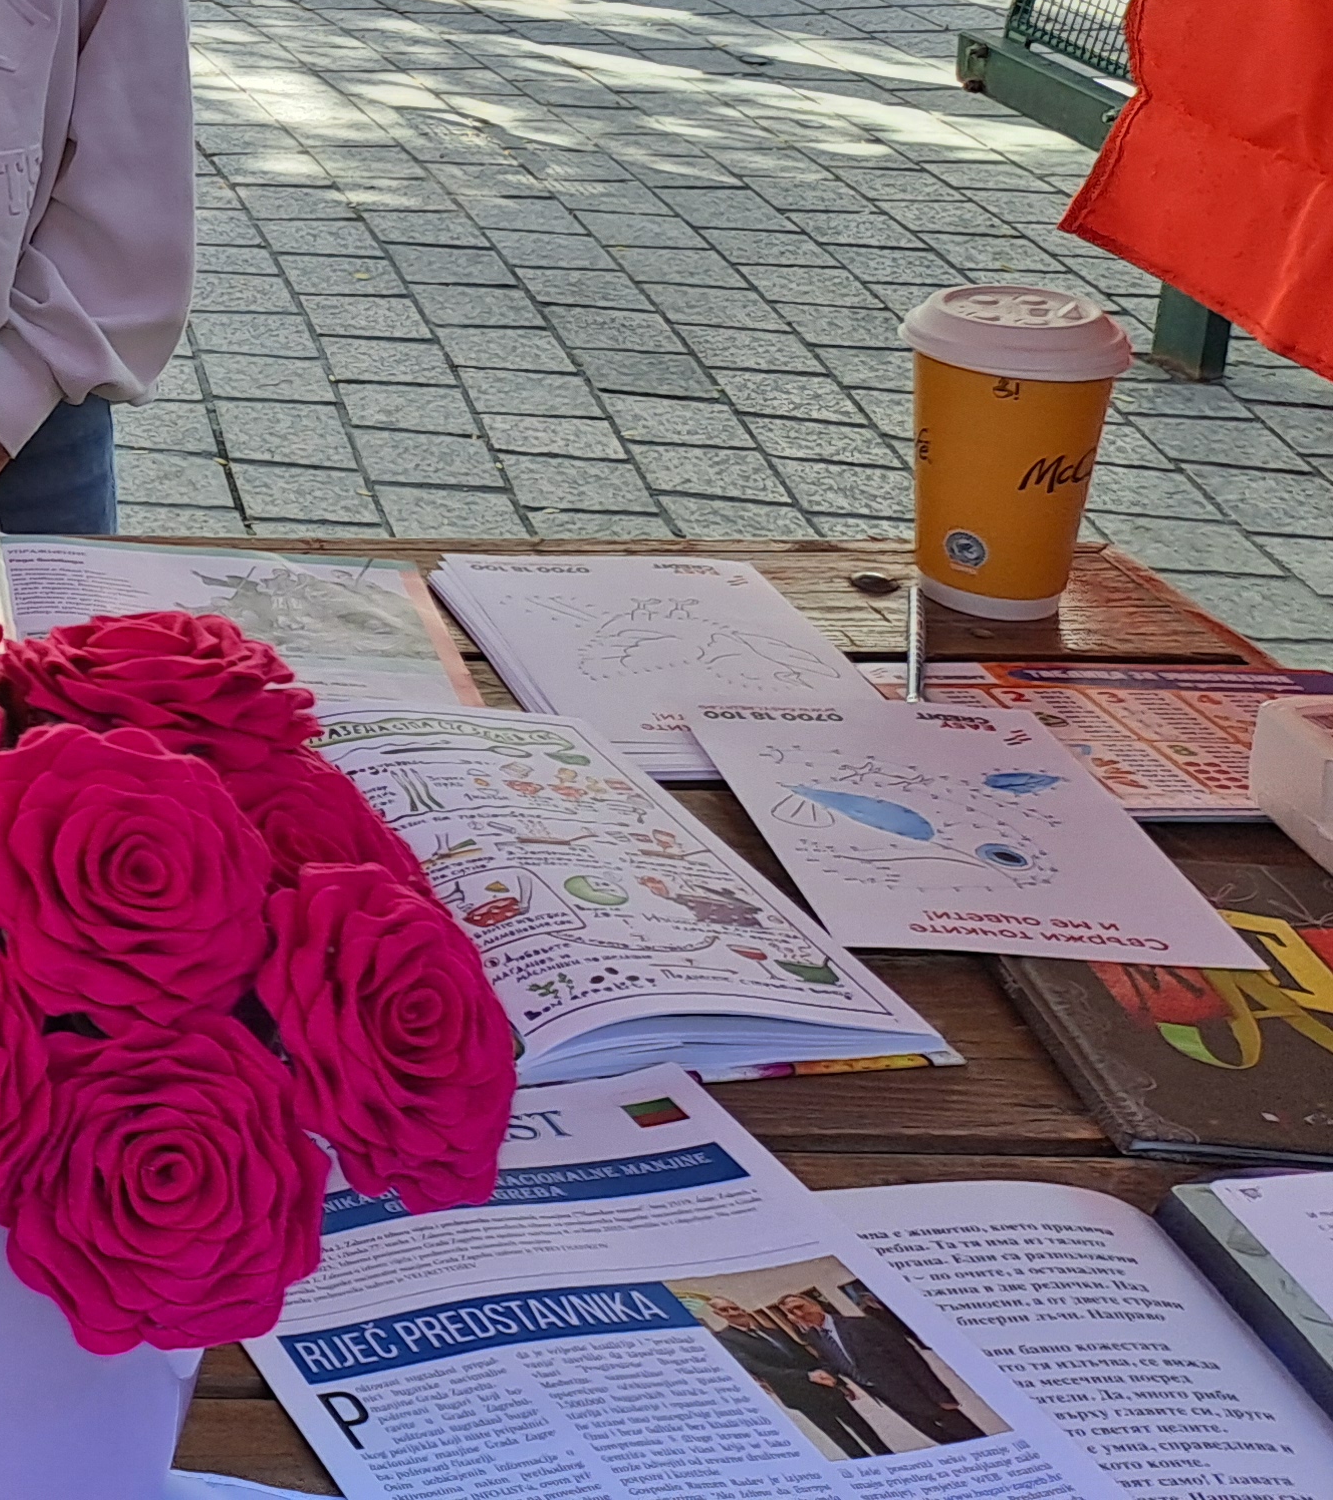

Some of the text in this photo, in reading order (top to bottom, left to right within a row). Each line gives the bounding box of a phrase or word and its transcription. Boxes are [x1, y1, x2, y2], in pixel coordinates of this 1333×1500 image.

[703, 710, 844, 722] 0700 18 100
[923, 910, 1121, 932] и ме оцвети!
[909, 923, 1170, 952] Свържи точките
[623, 1151, 713, 1178] MANJINE
[292, 1289, 671, 1374] RIJEČ PREDSTAVNIKA
